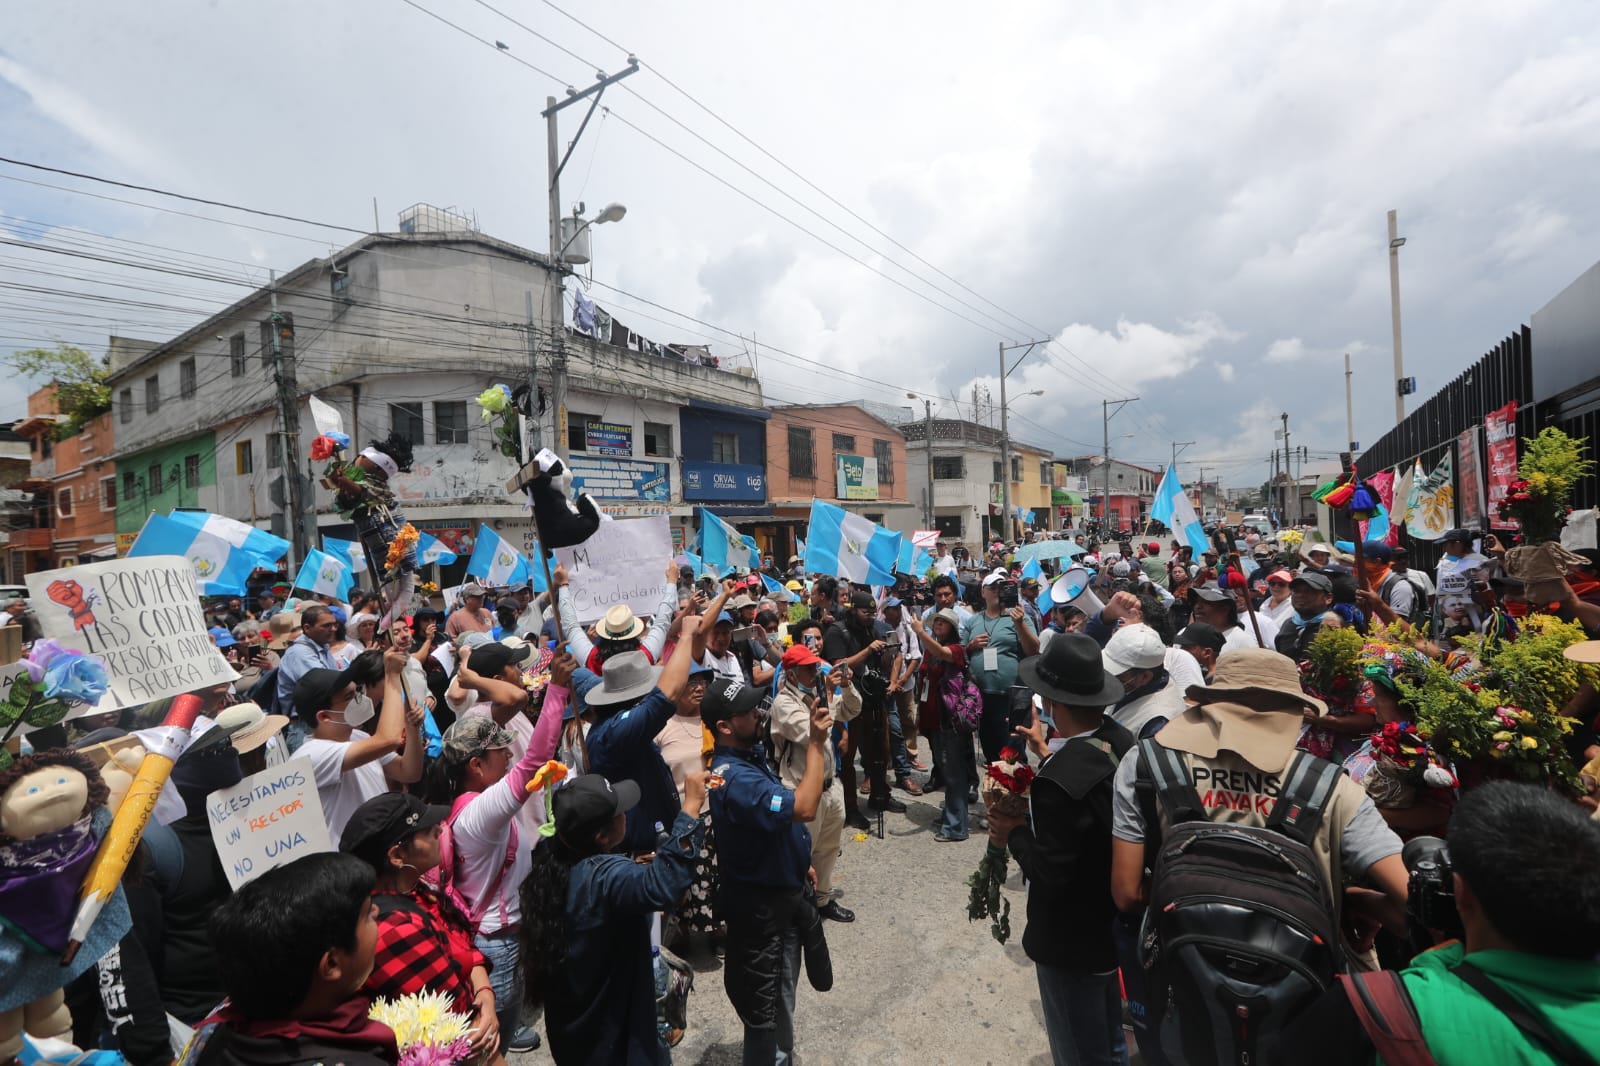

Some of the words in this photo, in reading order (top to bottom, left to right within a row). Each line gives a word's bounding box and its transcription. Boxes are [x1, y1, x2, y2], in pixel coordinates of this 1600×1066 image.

[604, 424, 632, 434] INTERNET
[713, 474, 736, 484] ORVAL
[747, 475, 762, 491] tigo
[81, 615, 131, 654] LAS
[209, 770, 307, 824] NECESITAMOS
[225, 827, 241, 846] UN
[234, 857, 253, 878] NO
[264, 831, 308, 858] UNA
